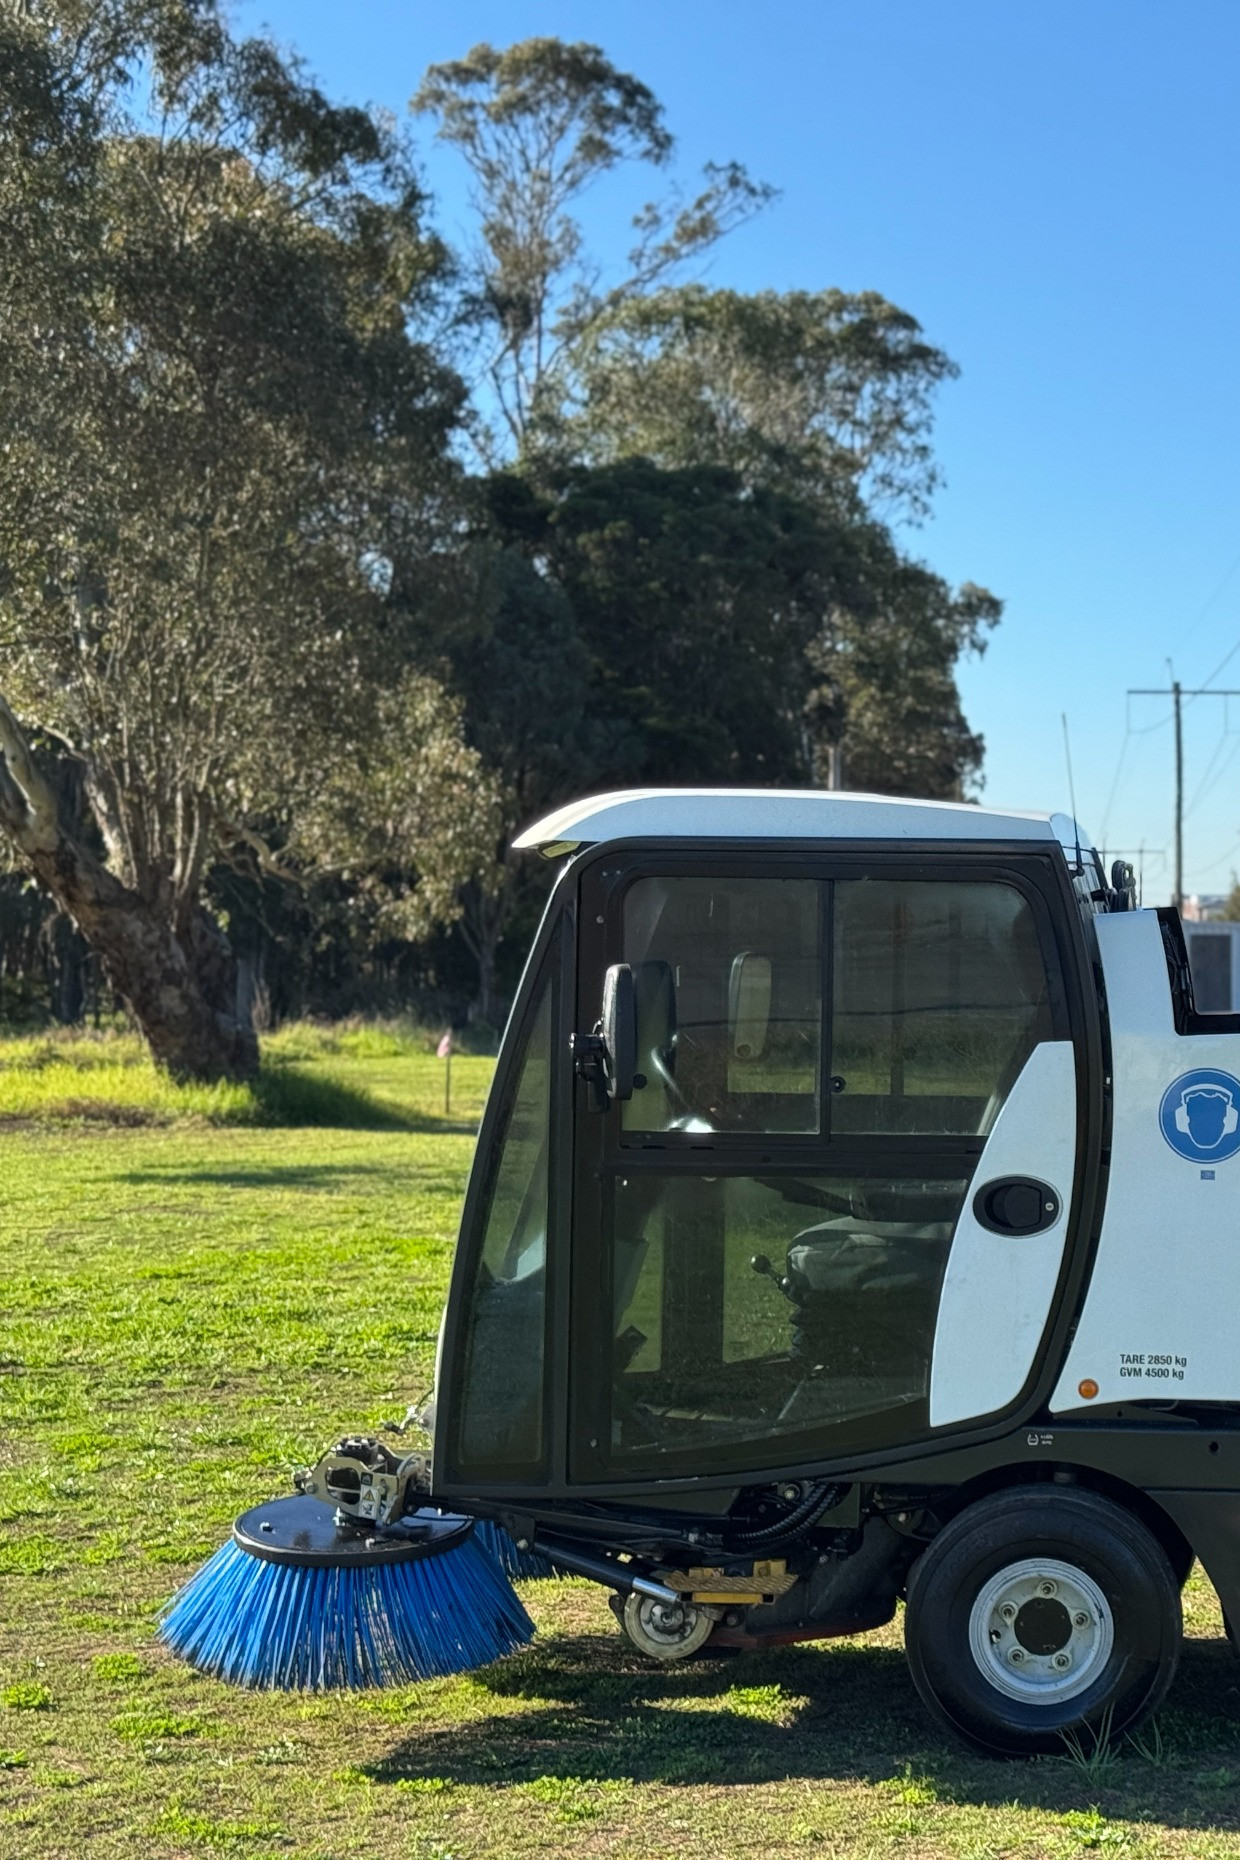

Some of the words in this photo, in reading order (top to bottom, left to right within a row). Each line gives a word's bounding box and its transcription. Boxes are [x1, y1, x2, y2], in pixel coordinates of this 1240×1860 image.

[1119, 1354, 1145, 1364] TARE
[1147, 1355, 1172, 1365] 2850
[1175, 1355, 1187, 1367] kg
[1120, 1367, 1142, 1377] GVM
[1145, 1368, 1169, 1378] 4500
[1172, 1368, 1184, 1380] kg
